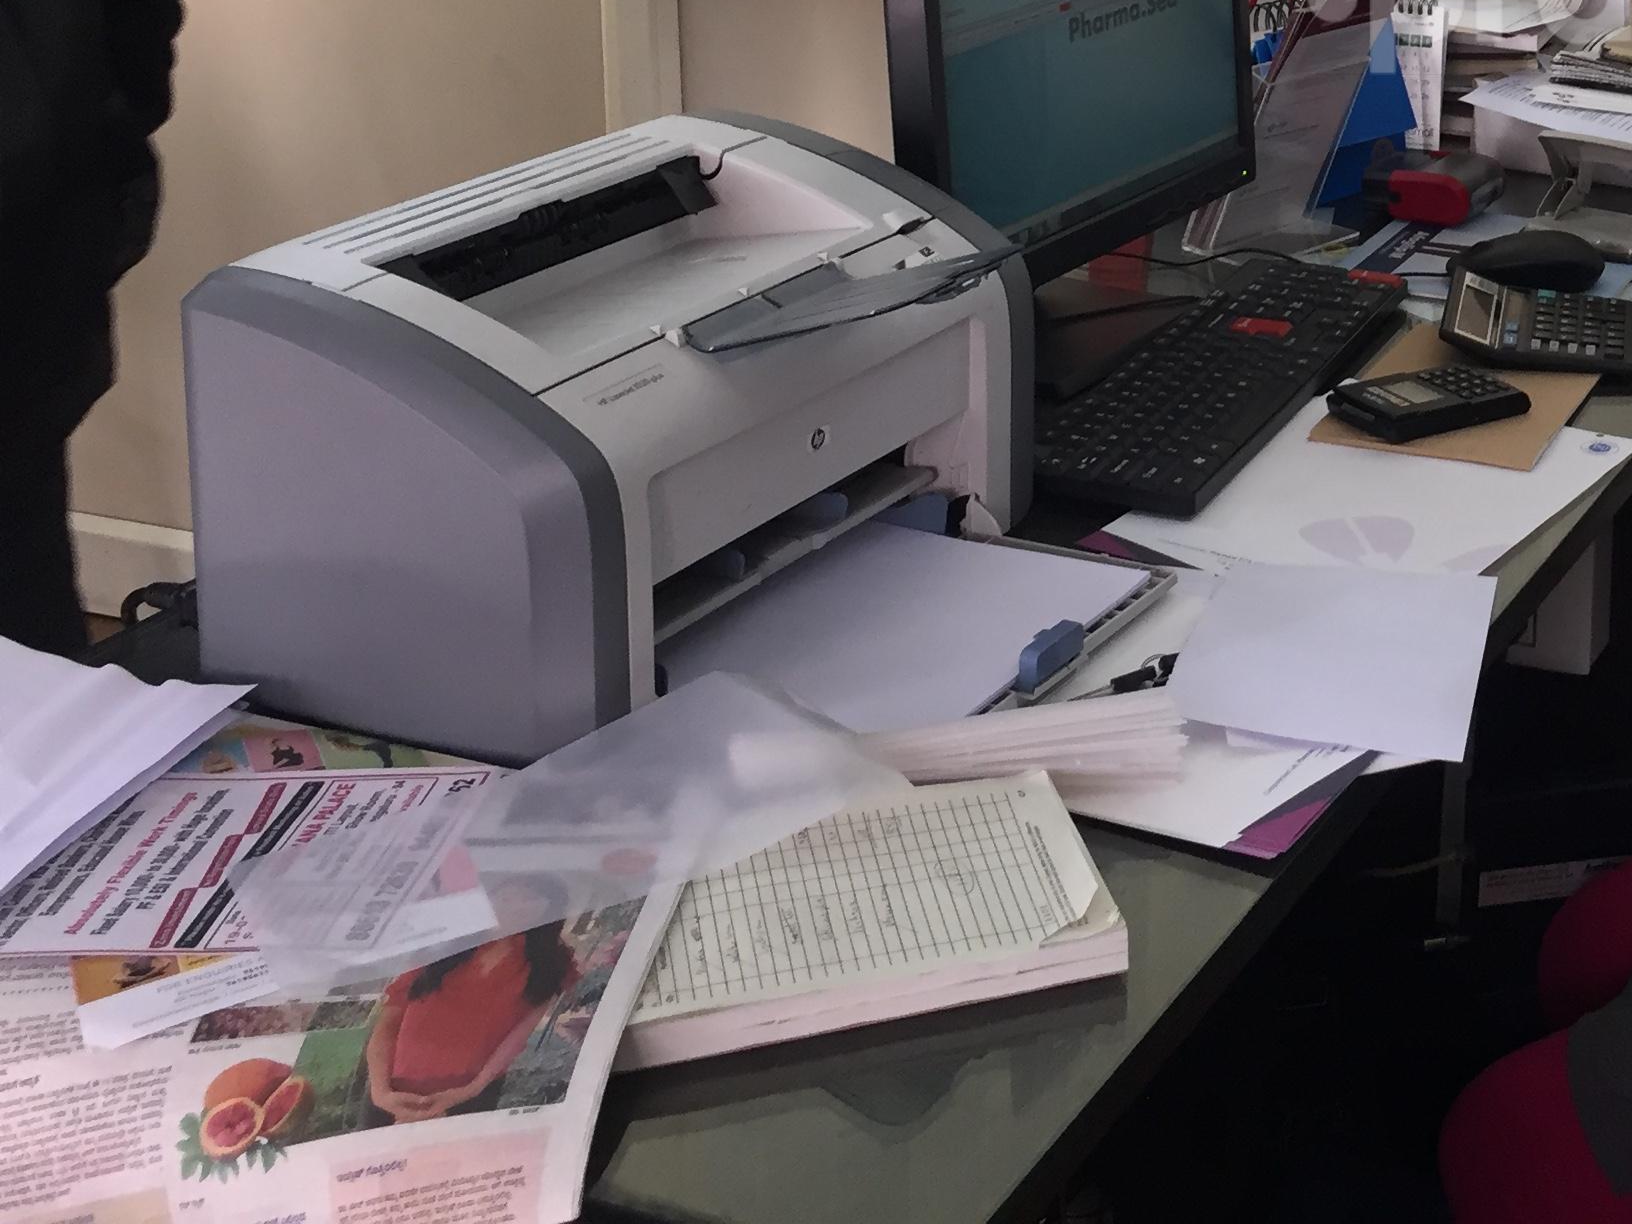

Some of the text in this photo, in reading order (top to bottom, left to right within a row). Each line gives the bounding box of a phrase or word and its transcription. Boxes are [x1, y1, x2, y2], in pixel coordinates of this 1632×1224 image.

[313, 783, 356, 820] PALACE
[61, 886, 121, 934] Absolutely
[104, 850, 148, 883] Flexible
[136, 826, 168, 847] Work
[156, 792, 202, 824] Timings
